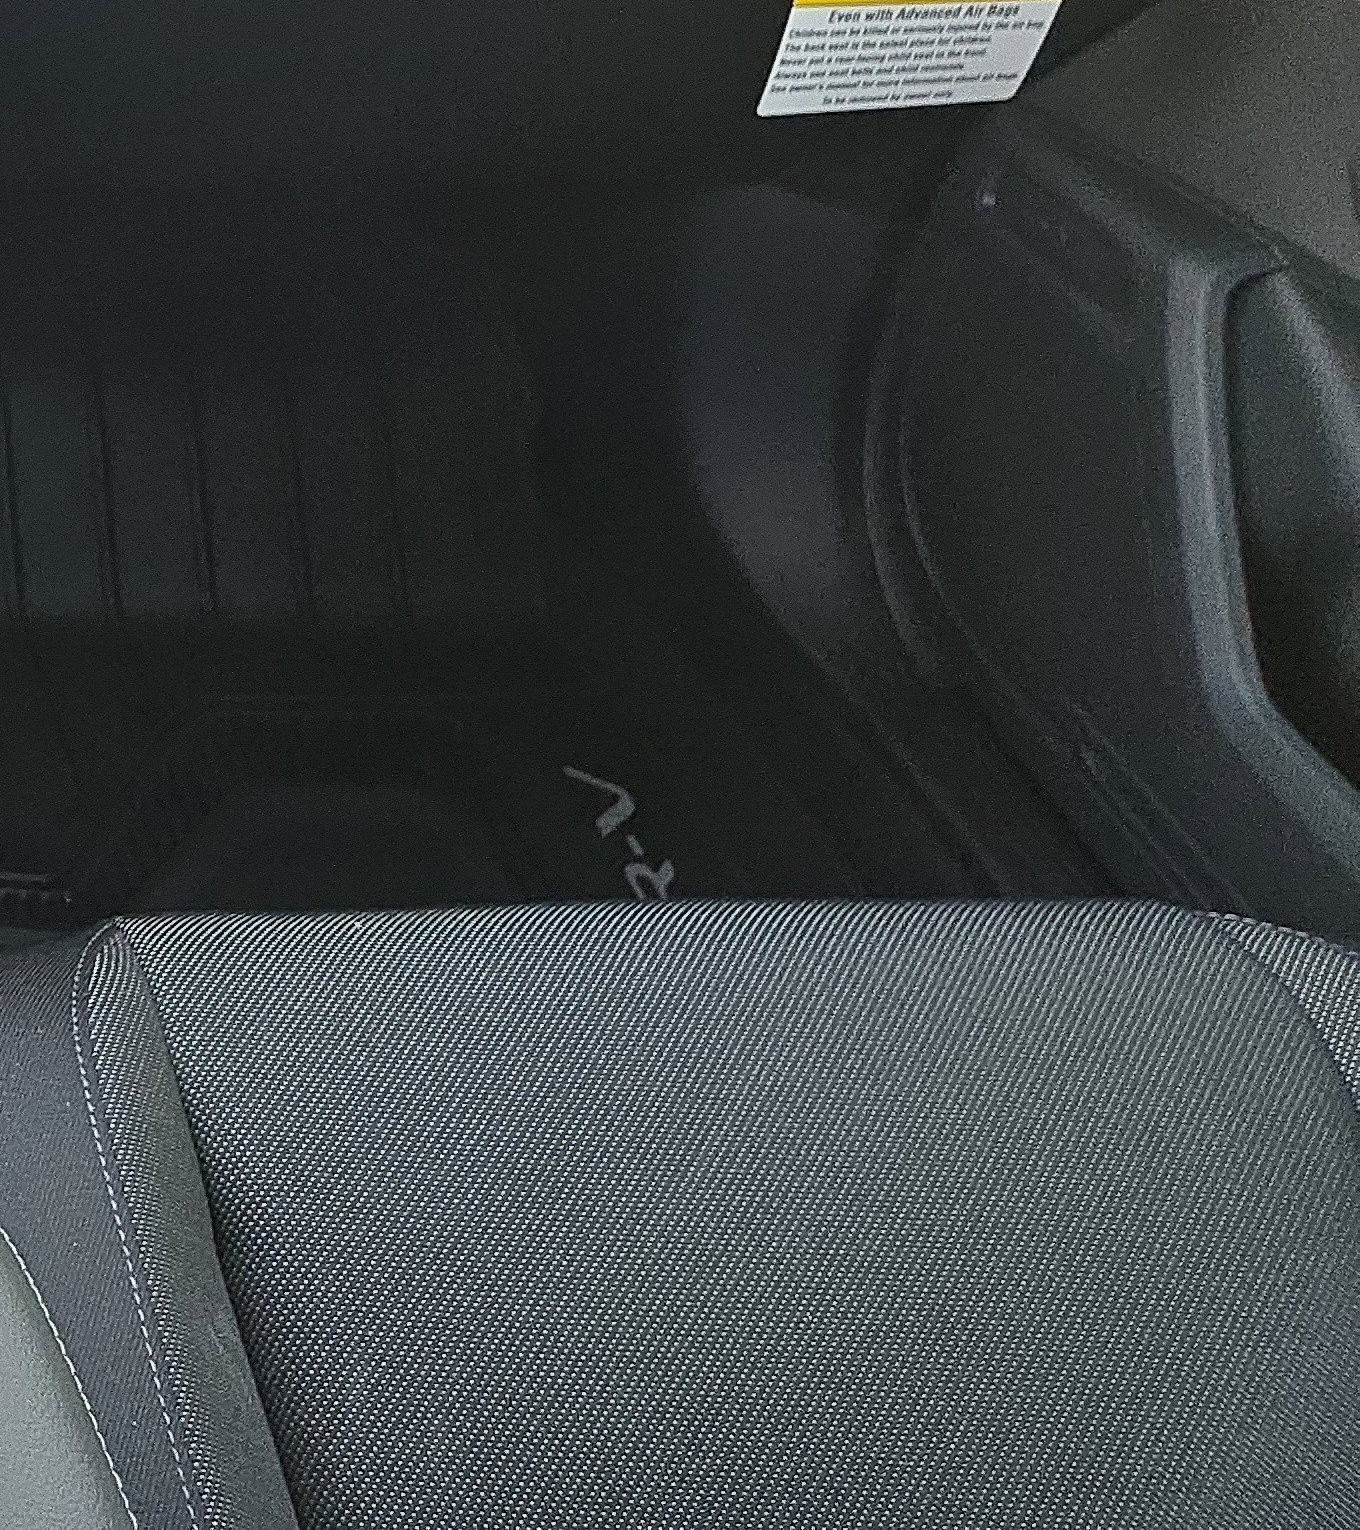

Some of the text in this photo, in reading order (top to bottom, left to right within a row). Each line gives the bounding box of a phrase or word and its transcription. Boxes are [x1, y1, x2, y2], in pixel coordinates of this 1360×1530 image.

[828, 4, 1020, 24] Even with Advanced Air Bags
